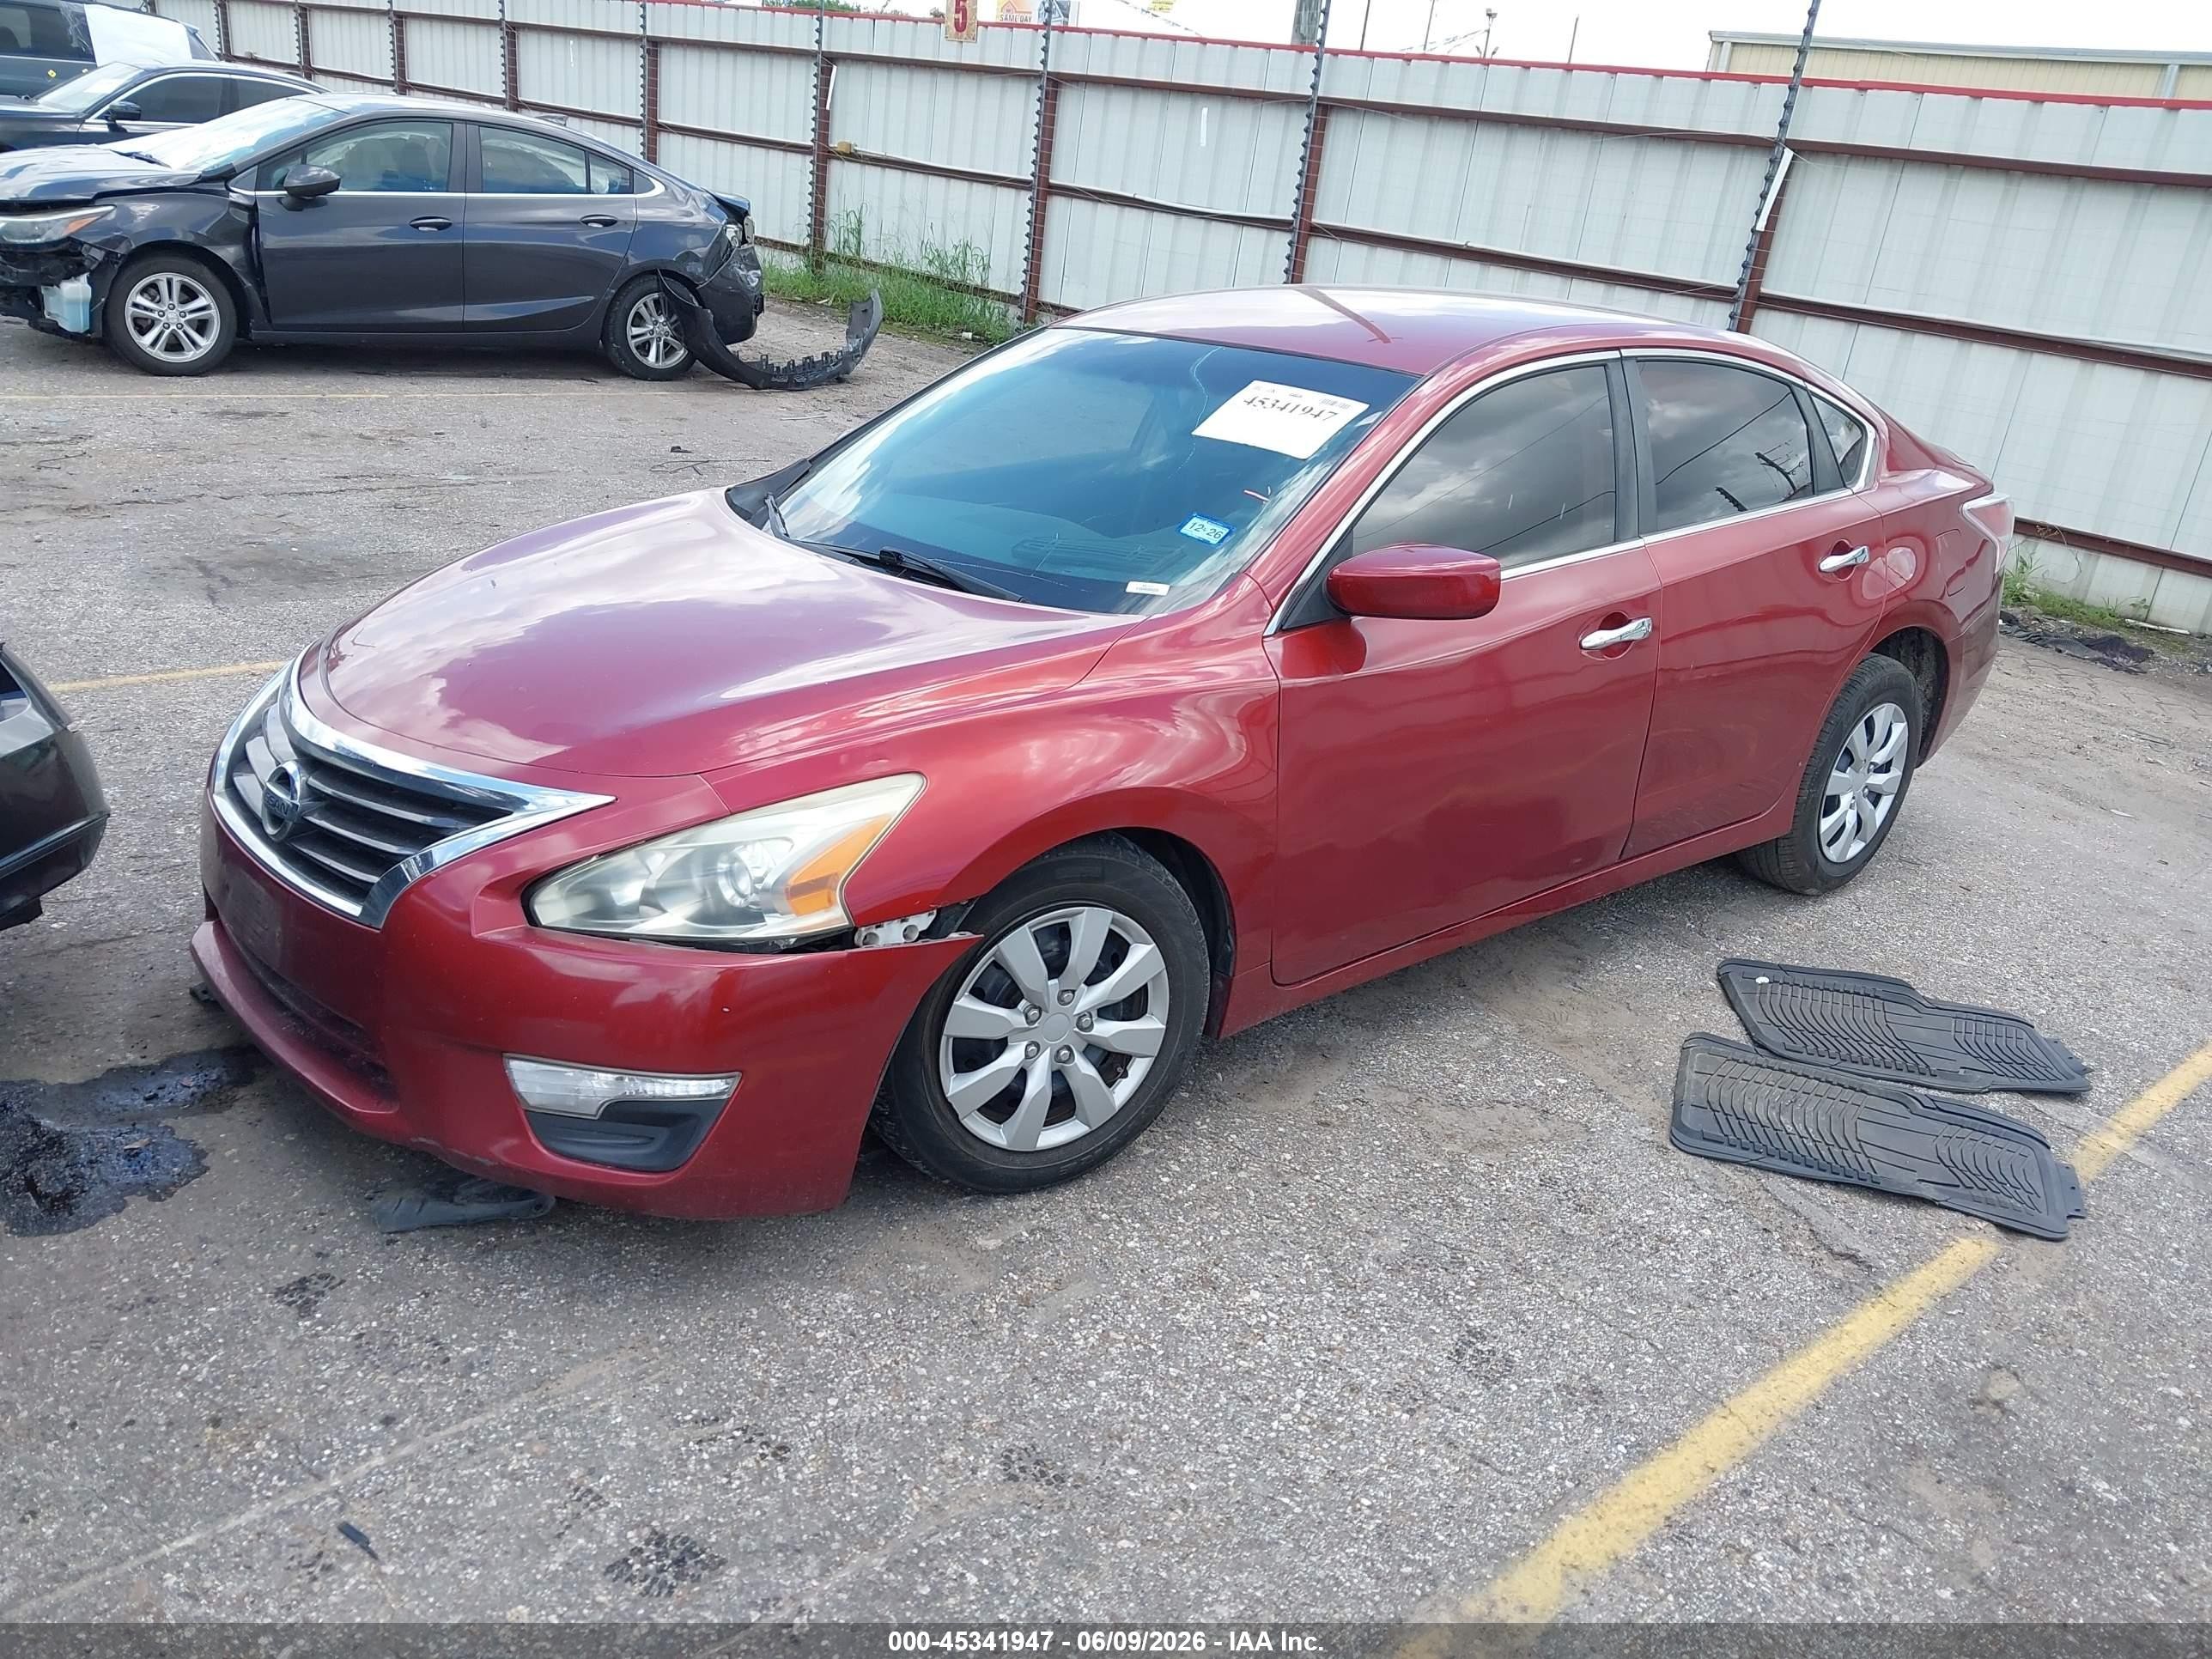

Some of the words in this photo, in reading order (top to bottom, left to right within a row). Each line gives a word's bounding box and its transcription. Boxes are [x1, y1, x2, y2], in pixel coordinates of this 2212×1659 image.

[954, 0, 968, 33] 5
[1019, 14, 1032, 22] DAY
[1243, 396, 1338, 421] 45341947
